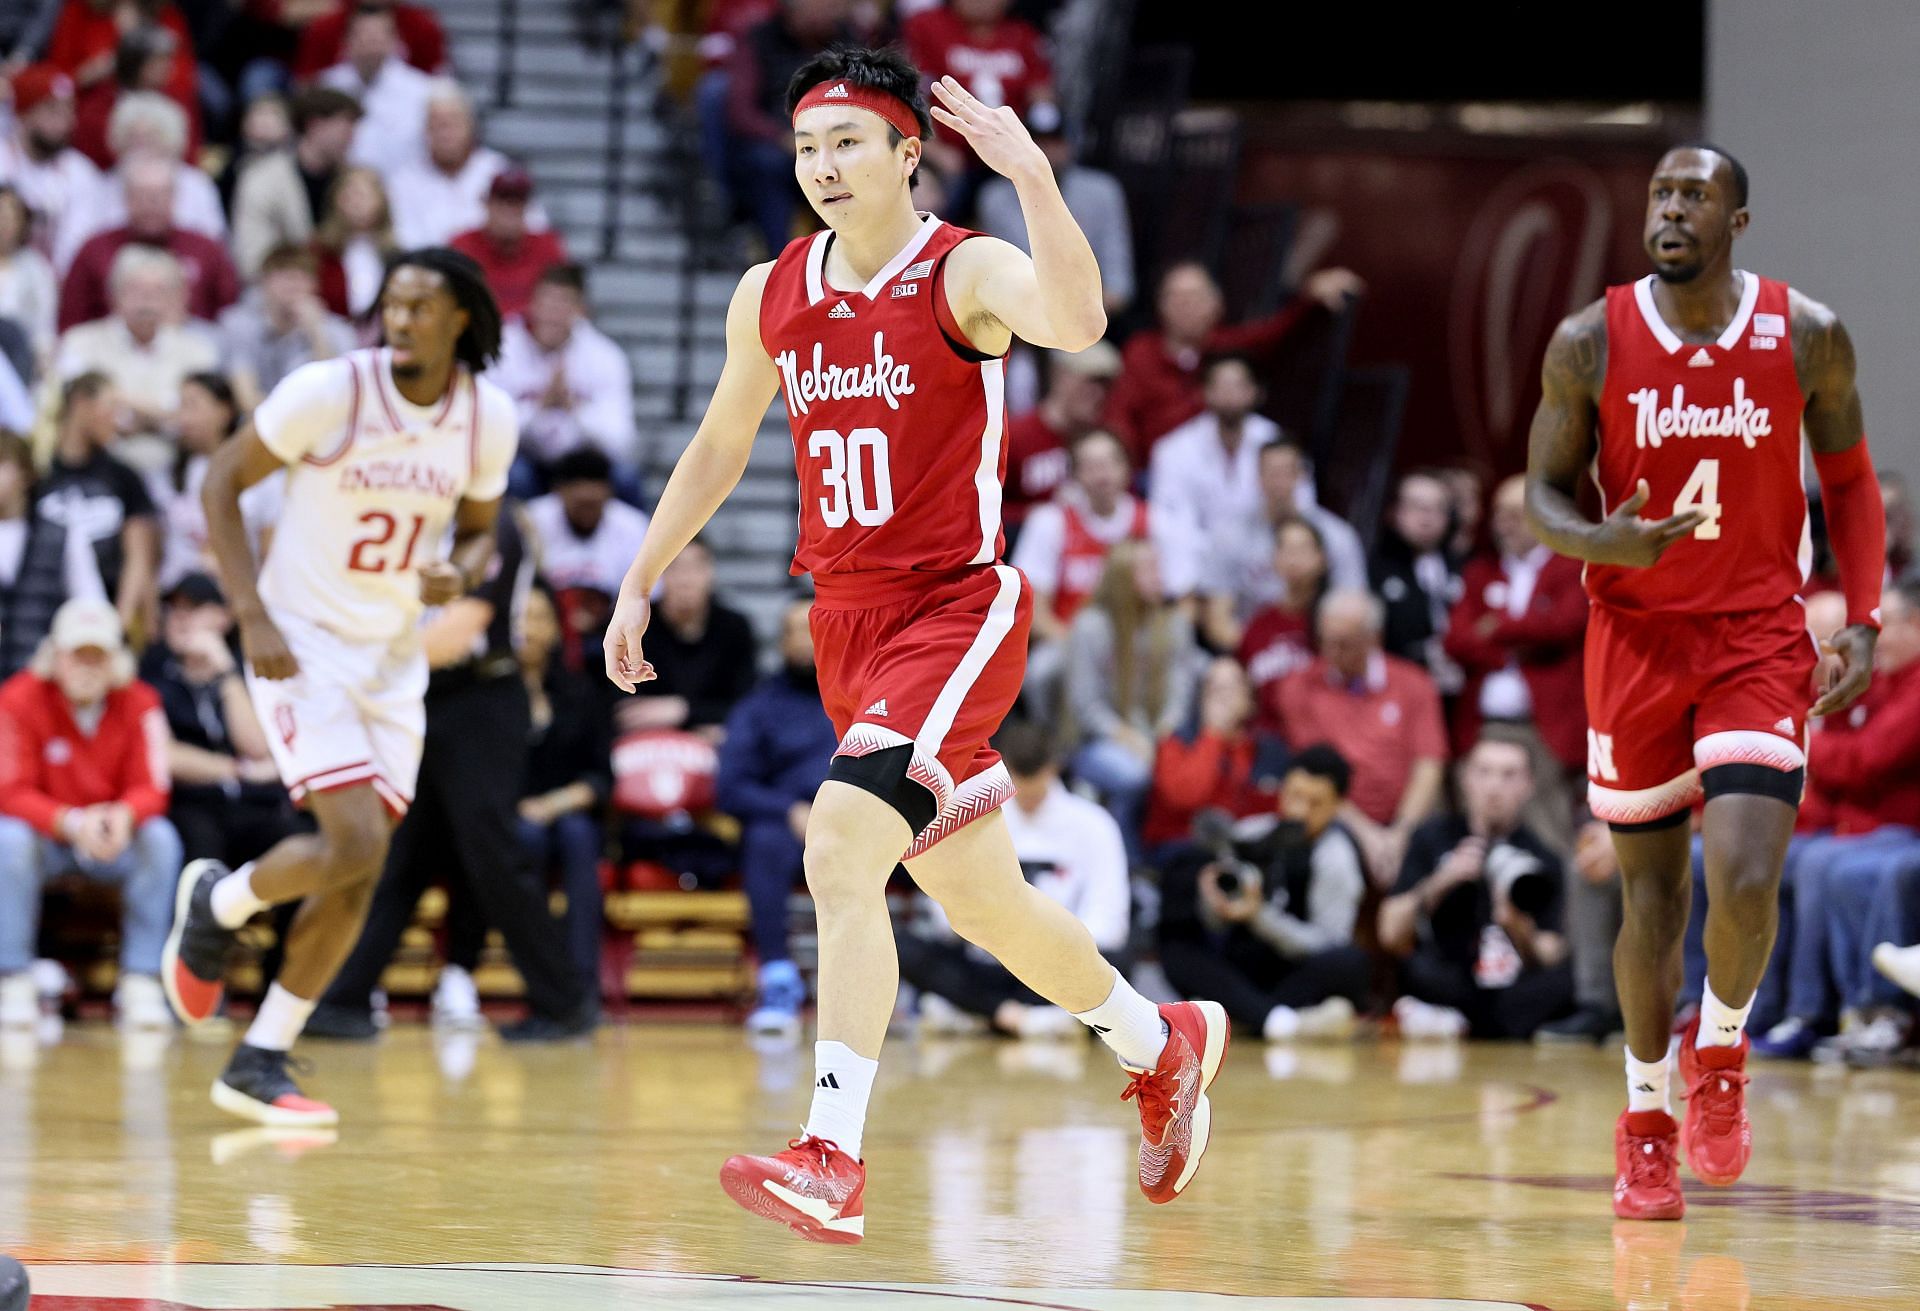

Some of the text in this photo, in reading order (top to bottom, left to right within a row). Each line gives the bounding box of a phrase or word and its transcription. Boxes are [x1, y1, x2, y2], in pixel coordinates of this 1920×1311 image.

[828, 310, 856, 319] adidas
[774, 331, 916, 418] Nebraska
[1627, 377, 1772, 448] Nebraska
[808, 427, 895, 528] 30
[1672, 458, 1722, 540] 4
[348, 510, 424, 573] 21
